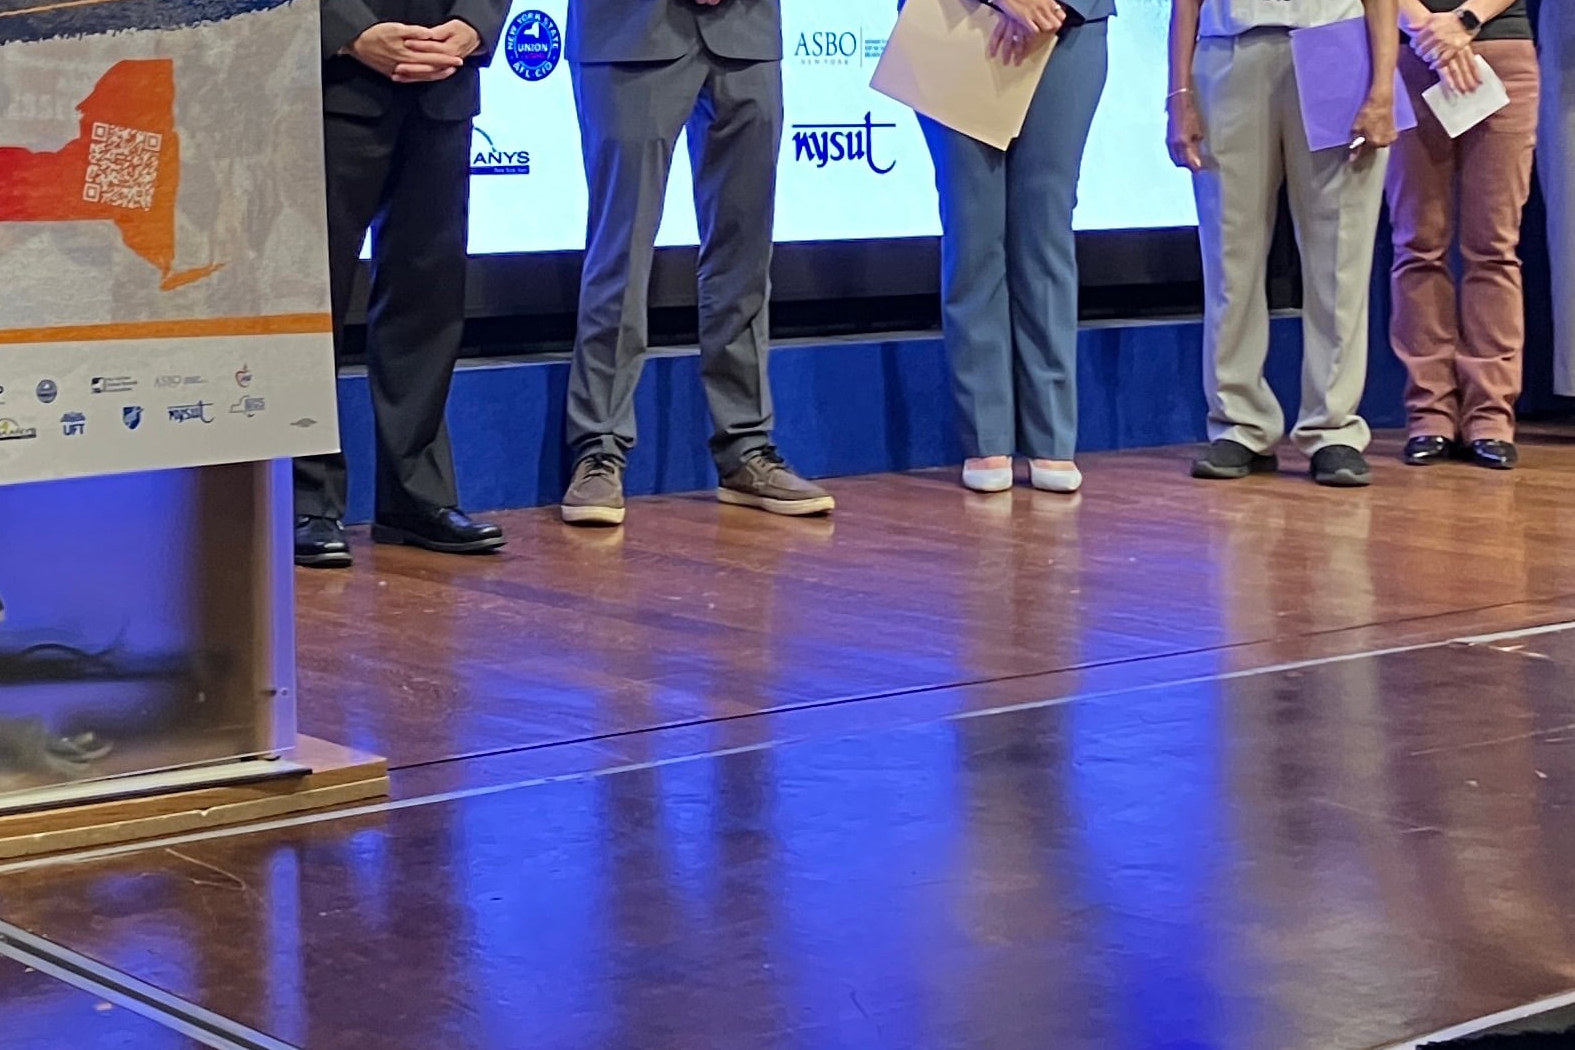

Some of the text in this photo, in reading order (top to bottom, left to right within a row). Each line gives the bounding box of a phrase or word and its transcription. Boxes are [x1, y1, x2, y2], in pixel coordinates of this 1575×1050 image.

[507, 12, 559, 50] NEW YORK STATE
[517, 43, 548, 53] UNION
[794, 31, 857, 57] ASBO
[472, 151, 530, 164] ANYS
[63, 423, 85, 436] UFT
